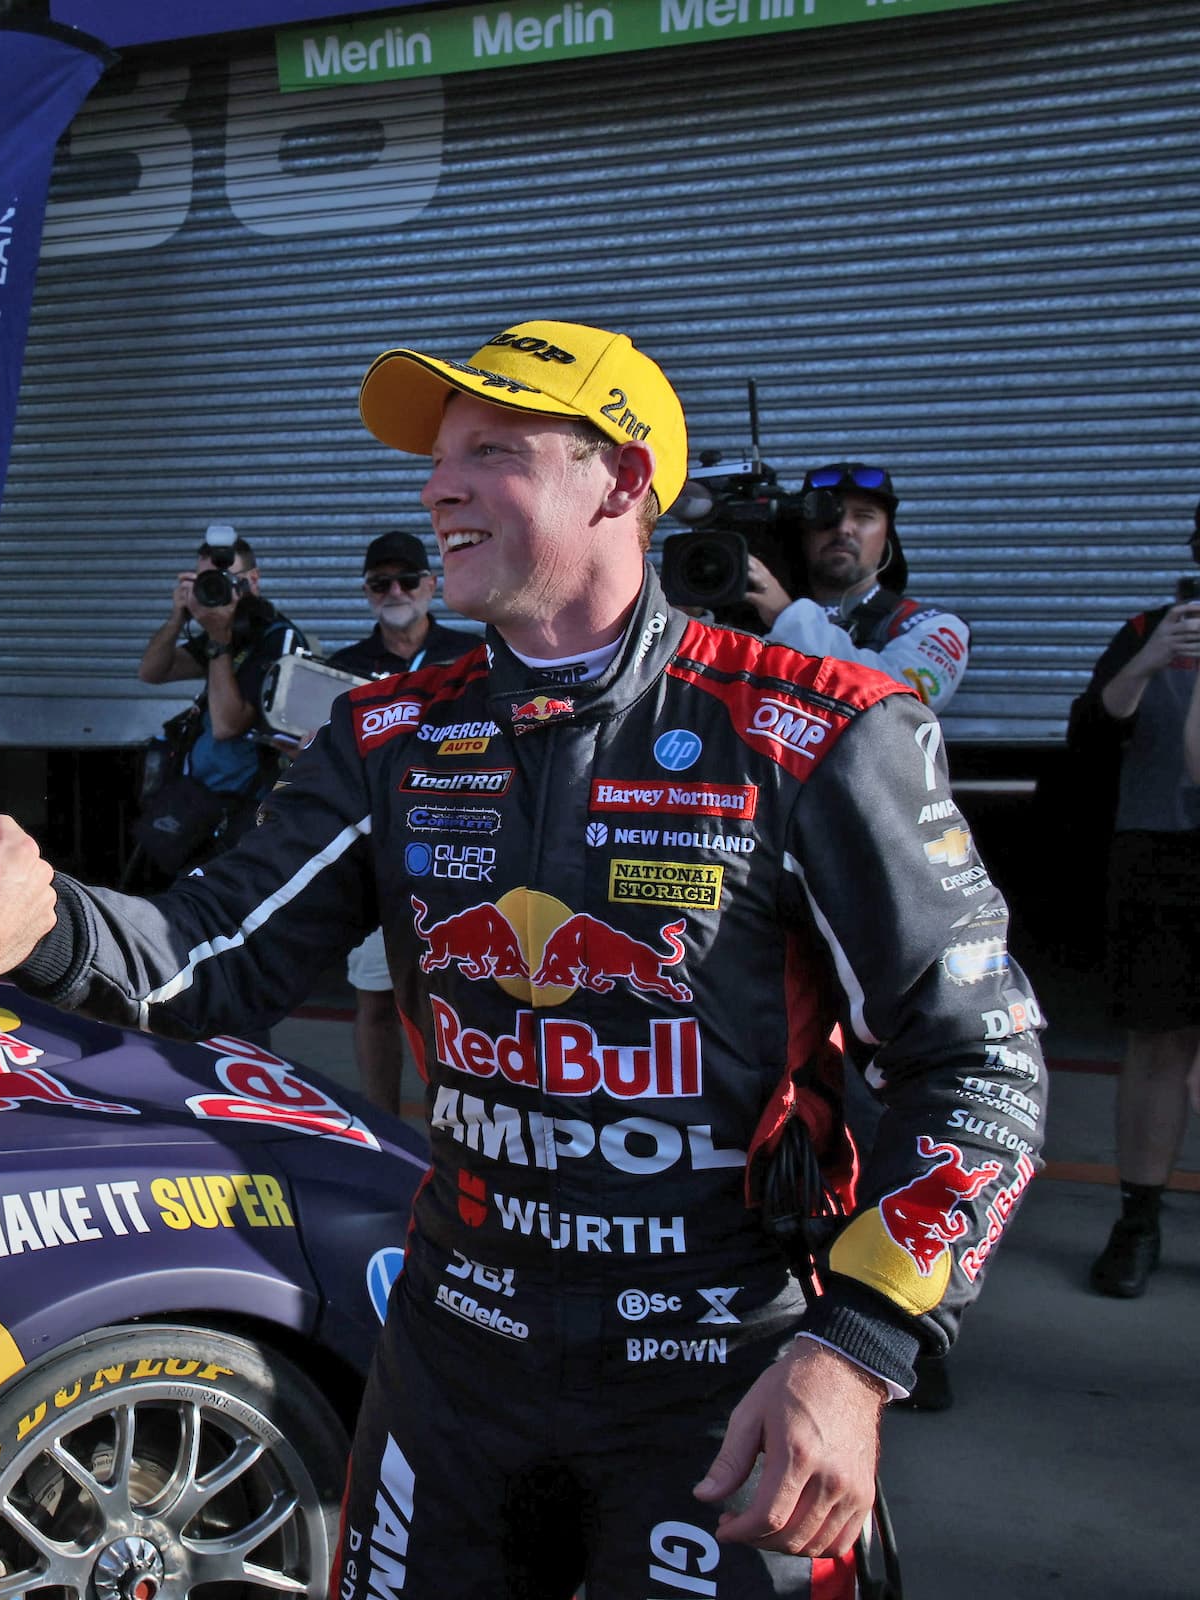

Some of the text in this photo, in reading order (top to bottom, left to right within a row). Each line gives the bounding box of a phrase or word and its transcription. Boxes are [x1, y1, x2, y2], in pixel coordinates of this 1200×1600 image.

[303, 27, 433, 79] Merlin
[471, 3, 614, 58] Merlin
[600, 388, 652, 441] 2nd
[361, 703, 421, 733] OMP
[753, 704, 826, 749] OMP
[445, 741, 483, 752] AUTO
[660, 731, 697, 769] hp
[596, 785, 746, 810] Harvey Norman
[434, 844, 497, 864] QUAD
[614, 828, 756, 853] NEW HOLLAND
[433, 861, 497, 883] LOCK
[615, 863, 717, 884] NATIONAL
[617, 881, 713, 903] STORAGE
[431, 1084, 748, 1175] AMPOL
[95, 1180, 152, 1237] IT
[150, 1174, 296, 1231] SUPER
[493, 1193, 687, 1254] WÜRTH
[437, 1283, 529, 1339] ACDelco
[626, 1337, 728, 1364] BROWN
[16, 1357, 234, 1442] DUNLOP
